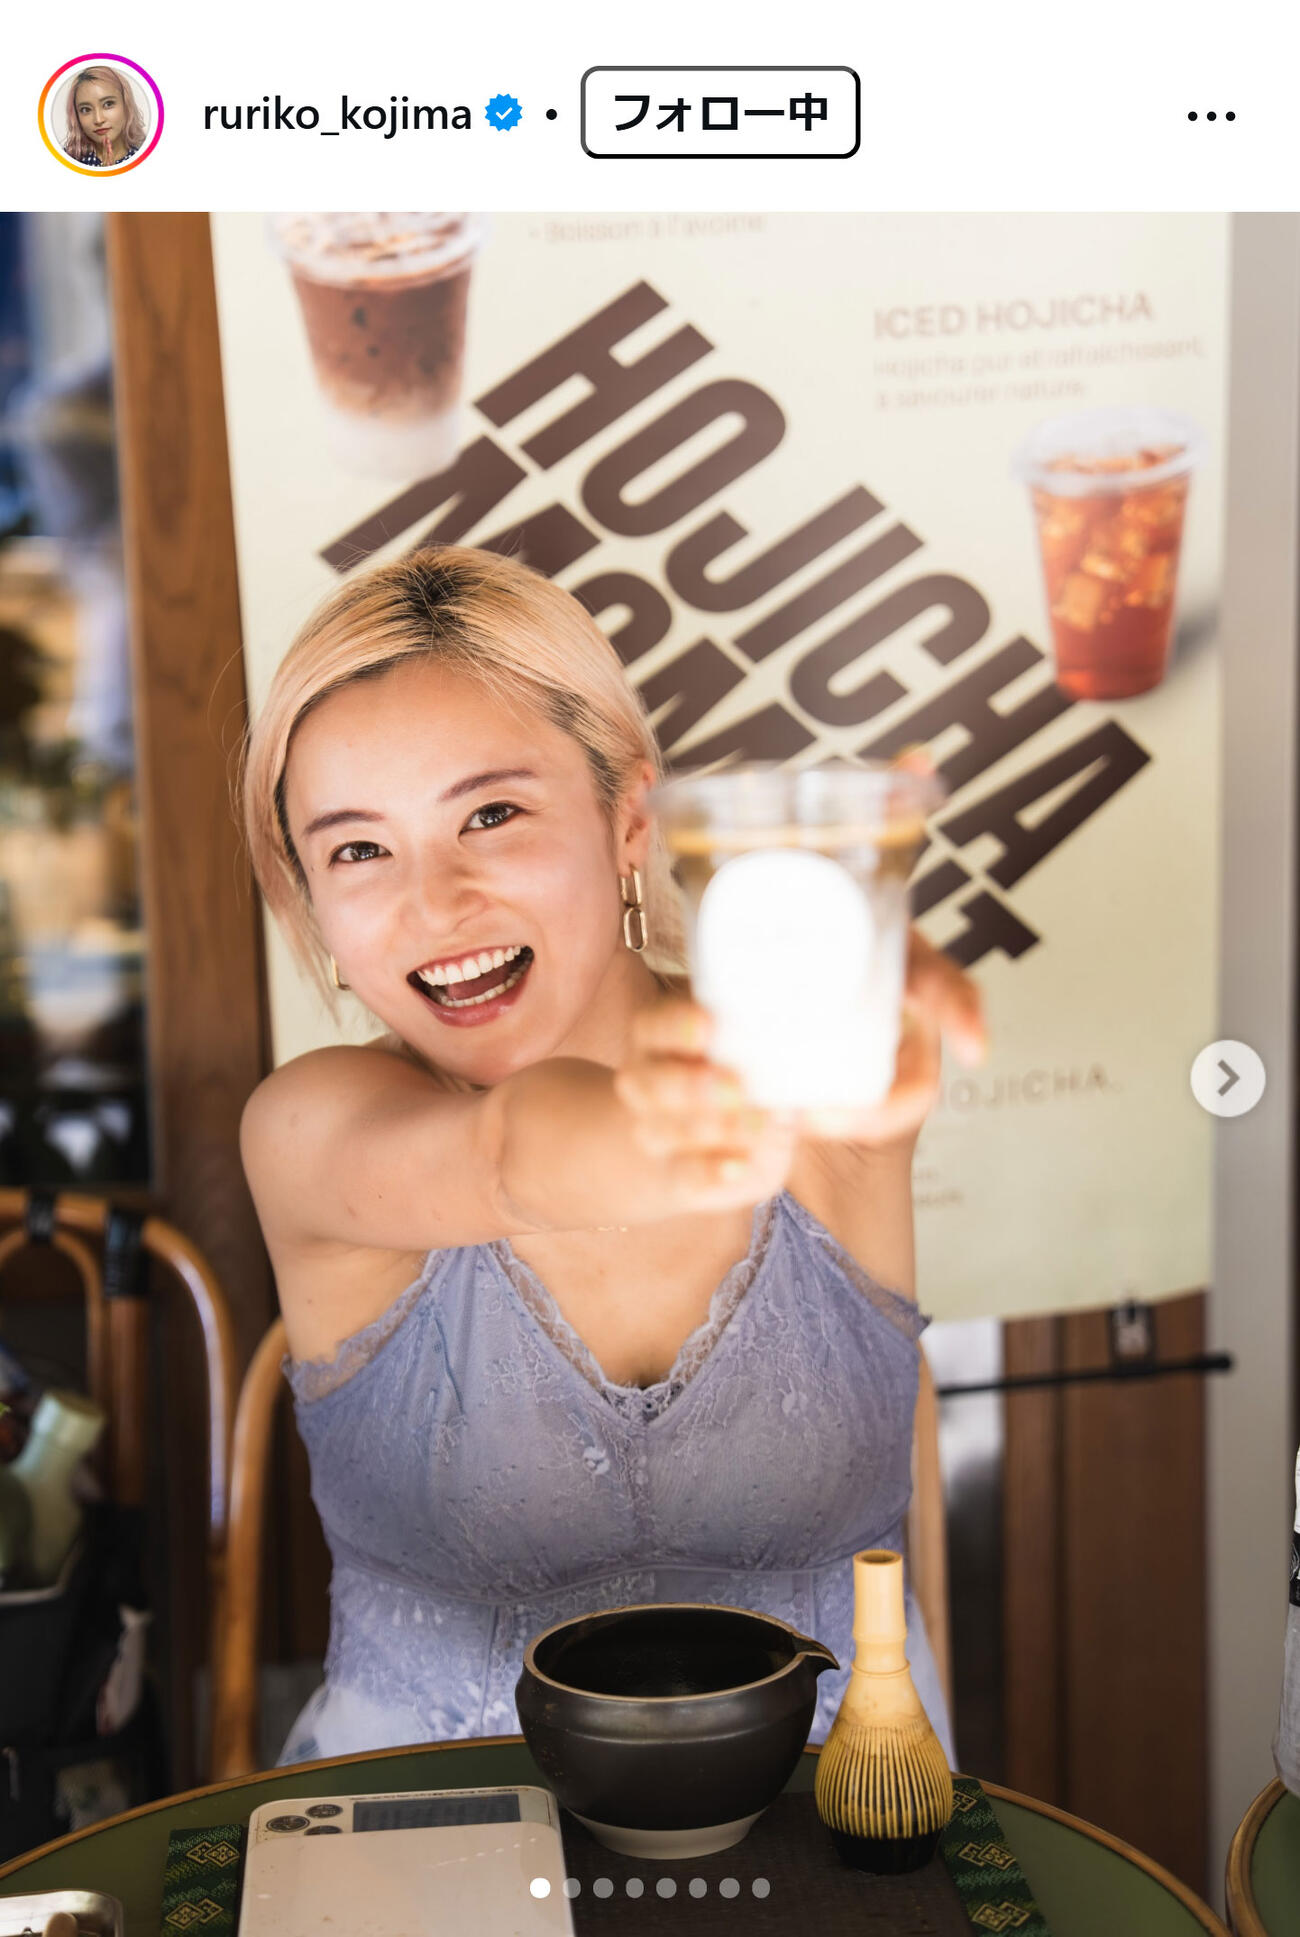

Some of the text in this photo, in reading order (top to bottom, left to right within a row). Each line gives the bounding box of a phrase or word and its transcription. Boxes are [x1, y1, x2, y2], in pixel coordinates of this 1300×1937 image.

[873, 290, 1155, 340] ICED HOJICHA
[474, 279, 1153, 891] HOJICHA
